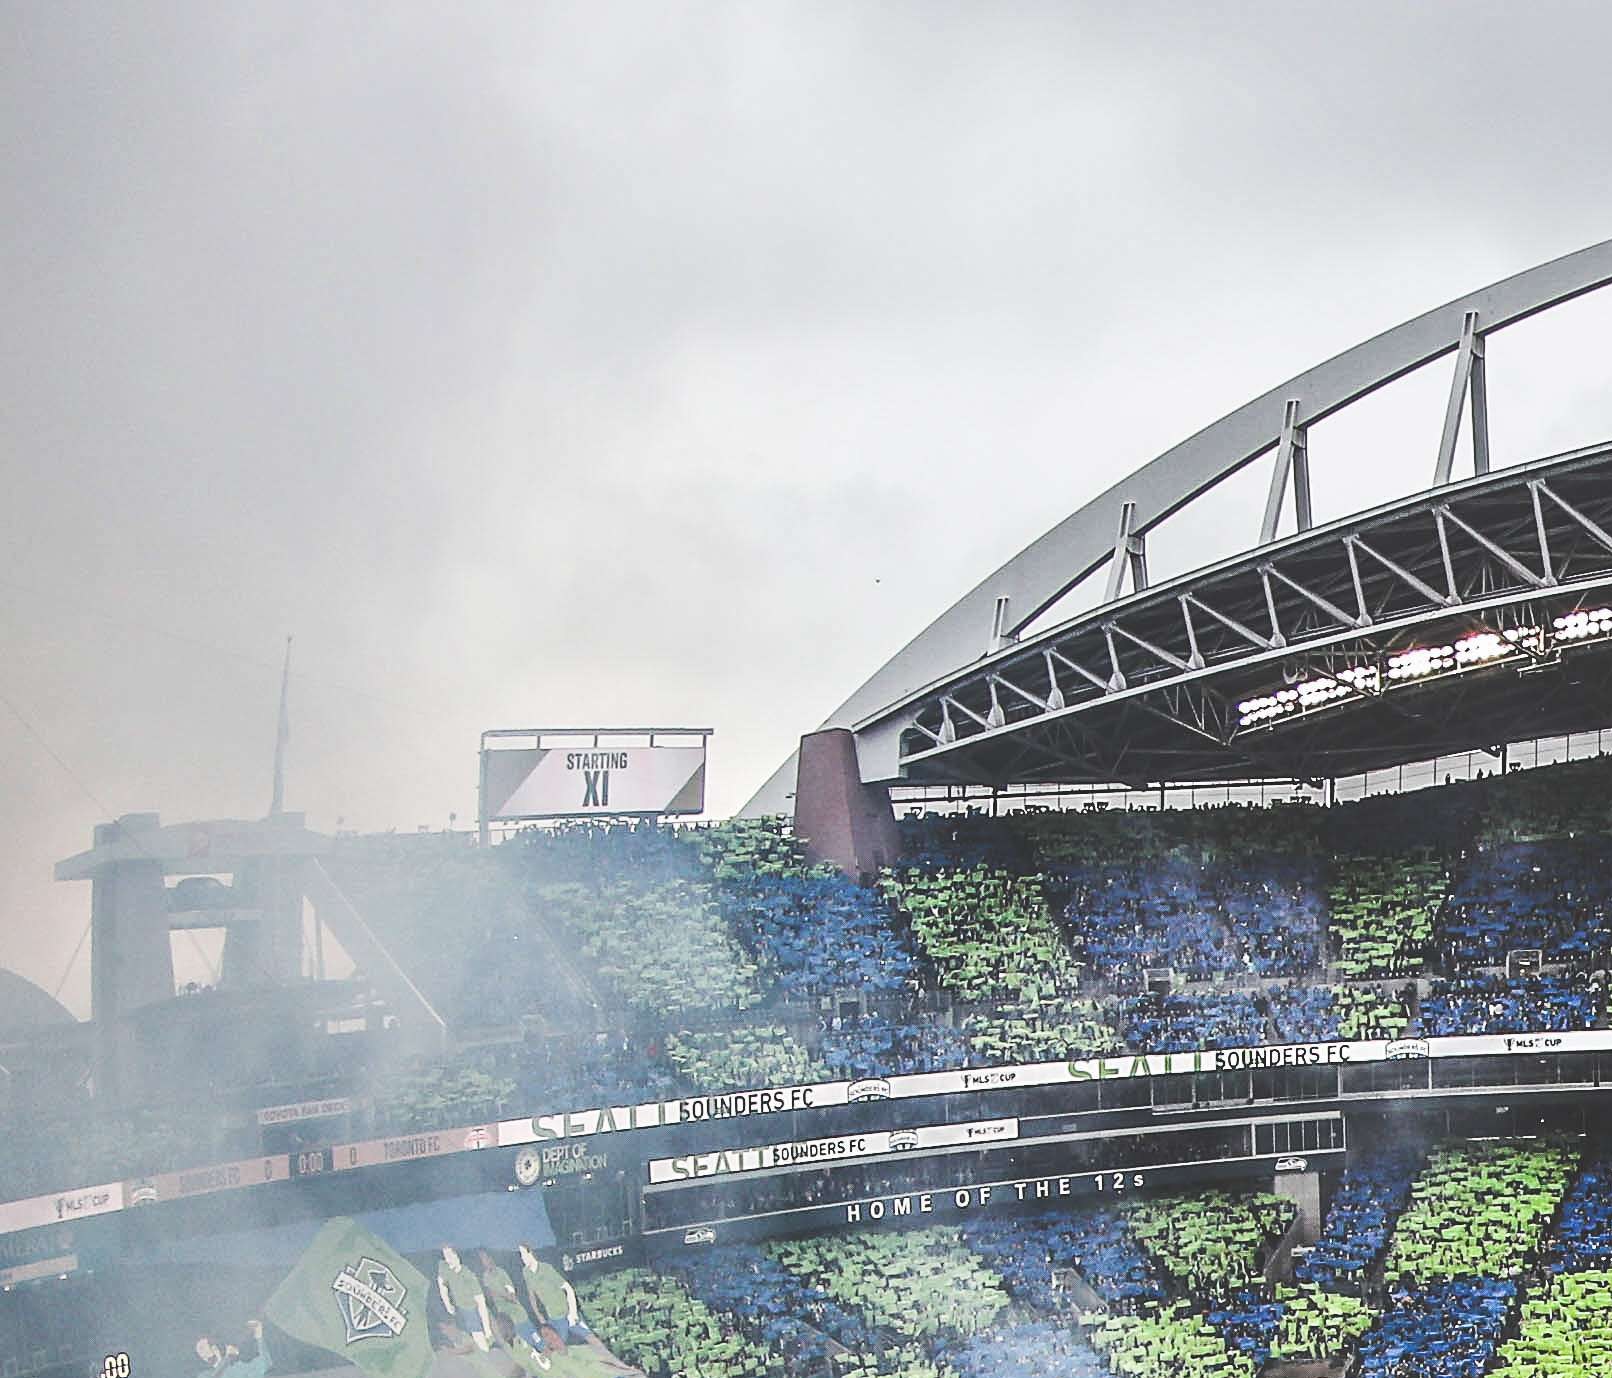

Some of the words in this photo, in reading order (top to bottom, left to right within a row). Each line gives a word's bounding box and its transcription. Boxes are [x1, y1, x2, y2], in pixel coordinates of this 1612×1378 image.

[565, 751, 628, 771] STARTING
[582, 769, 609, 808] XI
[1516, 1038, 1535, 1049] MLS
[1544, 1037, 1562, 1048] CUP
[1215, 1046, 1320, 1069] SOUNDERS
[1327, 1044, 1350, 1063] FC
[1000, 1071, 1017, 1083] CUP
[679, 1089, 785, 1122] SOUNDERS
[792, 1088, 814, 1107] FC
[542, 1146, 568, 1161] DEPT
[572, 1143, 587, 1157] OF
[772, 1141, 847, 1163] SOUNDERS
[849, 1138, 866, 1152] FC
[846, 1194, 936, 1224] HOME
[955, 1187, 993, 1210] OF
[1014, 1177, 1073, 1200] THE
[1094, 1172, 1146, 1191] 12s
[575, 1245, 624, 1265] STARBUCKS
